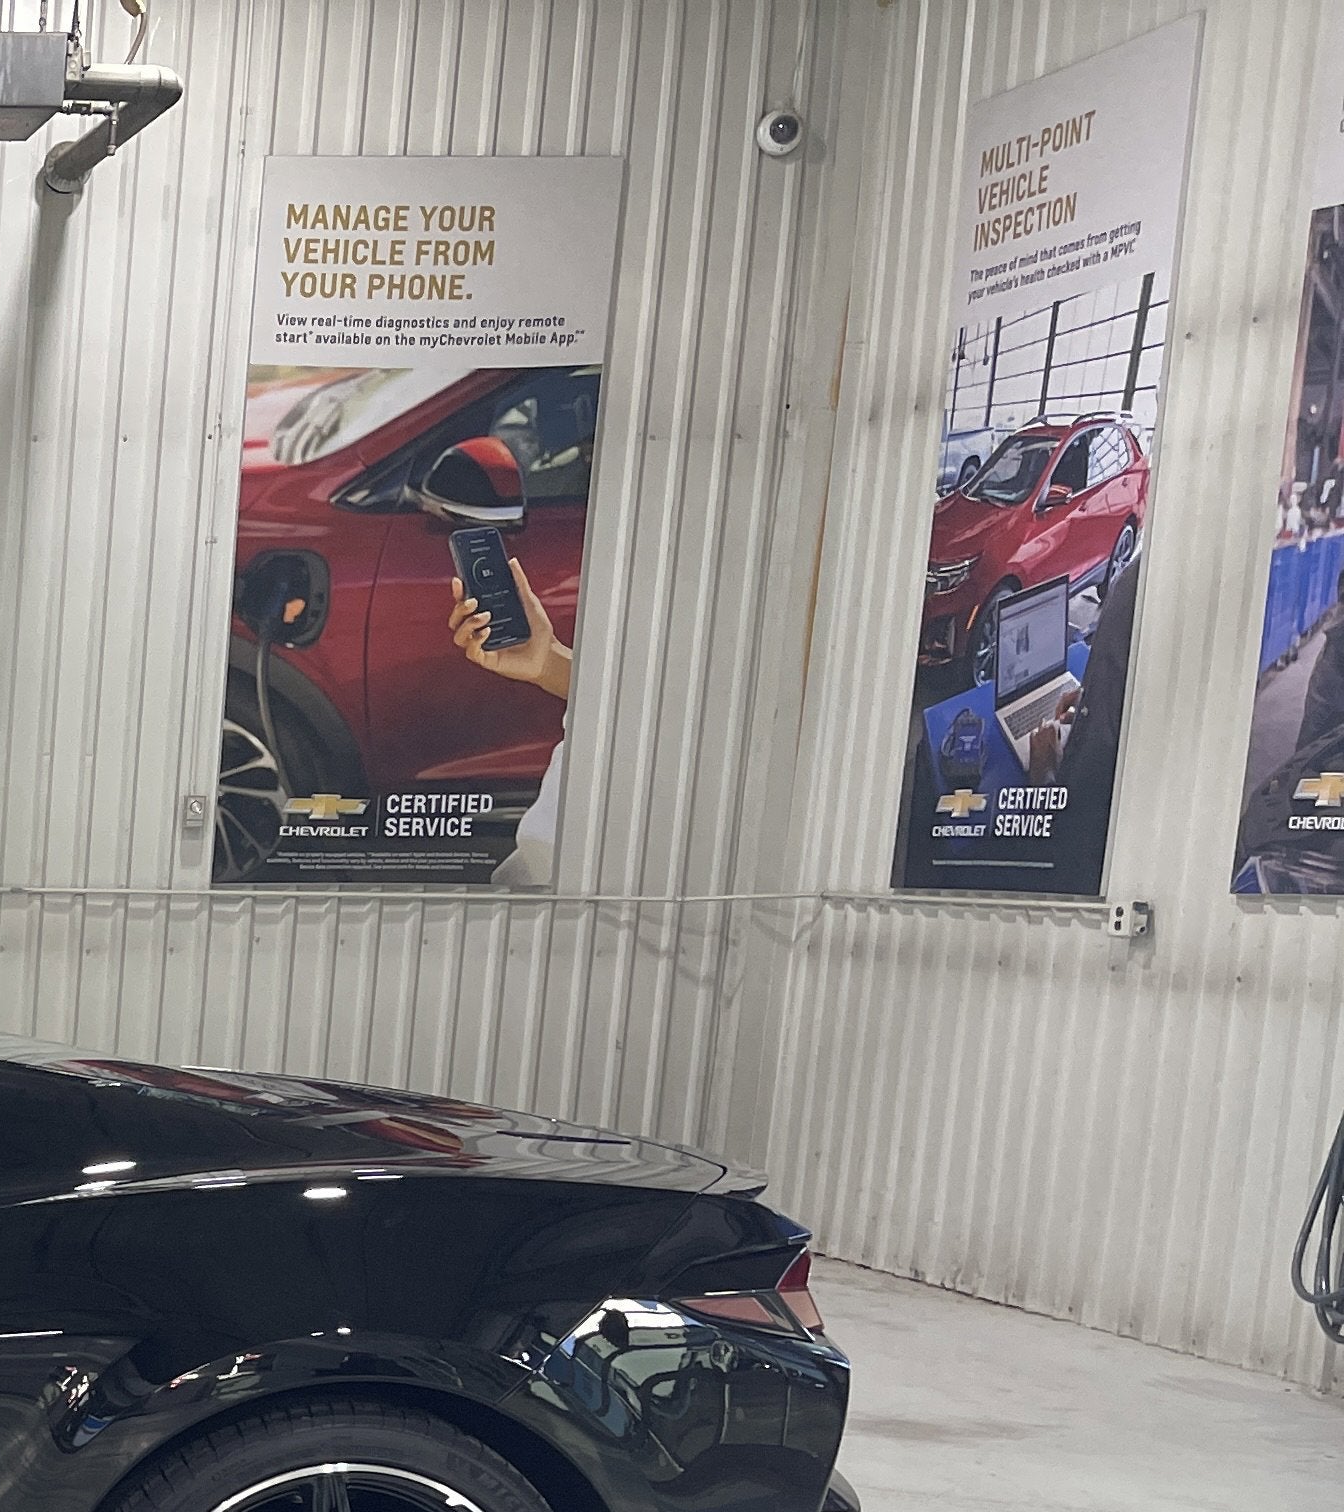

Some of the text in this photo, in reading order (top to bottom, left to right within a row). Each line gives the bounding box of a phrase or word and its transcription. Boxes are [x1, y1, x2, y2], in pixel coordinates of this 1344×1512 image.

[981, 109, 1096, 177] MULTI-POINT
[978, 164, 1049, 214] VEHICLE
[286, 203, 495, 232] MANAGE YOUR
[974, 192, 1077, 252] INSPECTION
[284, 237, 495, 266] VEHICLE FROM
[971, 221, 1141, 282] The peace of mind that comes from getting
[281, 271, 473, 301] YOUR PHONE.
[968, 287, 985, 305] your
[987, 275, 1018, 295] vehicle's
[1020, 268, 1045, 286] health
[1047, 256, 1080, 278] checked
[1082, 250, 1101, 267] with
[1103, 251, 1108, 262] a
[277, 313, 565, 331] View real-time diagnostics and enjoy remote
[315, 332, 371, 345] available
[375, 336, 391, 345] on
[395, 333, 416, 346] the
[420, 333, 501, 349] myChevrolet
[505, 333, 546, 346] Mobile
[386, 794, 493, 814] CERTIFIED
[998, 787, 1067, 811] CERTIFIED
[279, 824, 369, 838] CHEVROLET
[384, 817, 472, 838] SERVICE
[931, 824, 986, 838] CHEVROLET
[994, 814, 1052, 838] SERVICE
